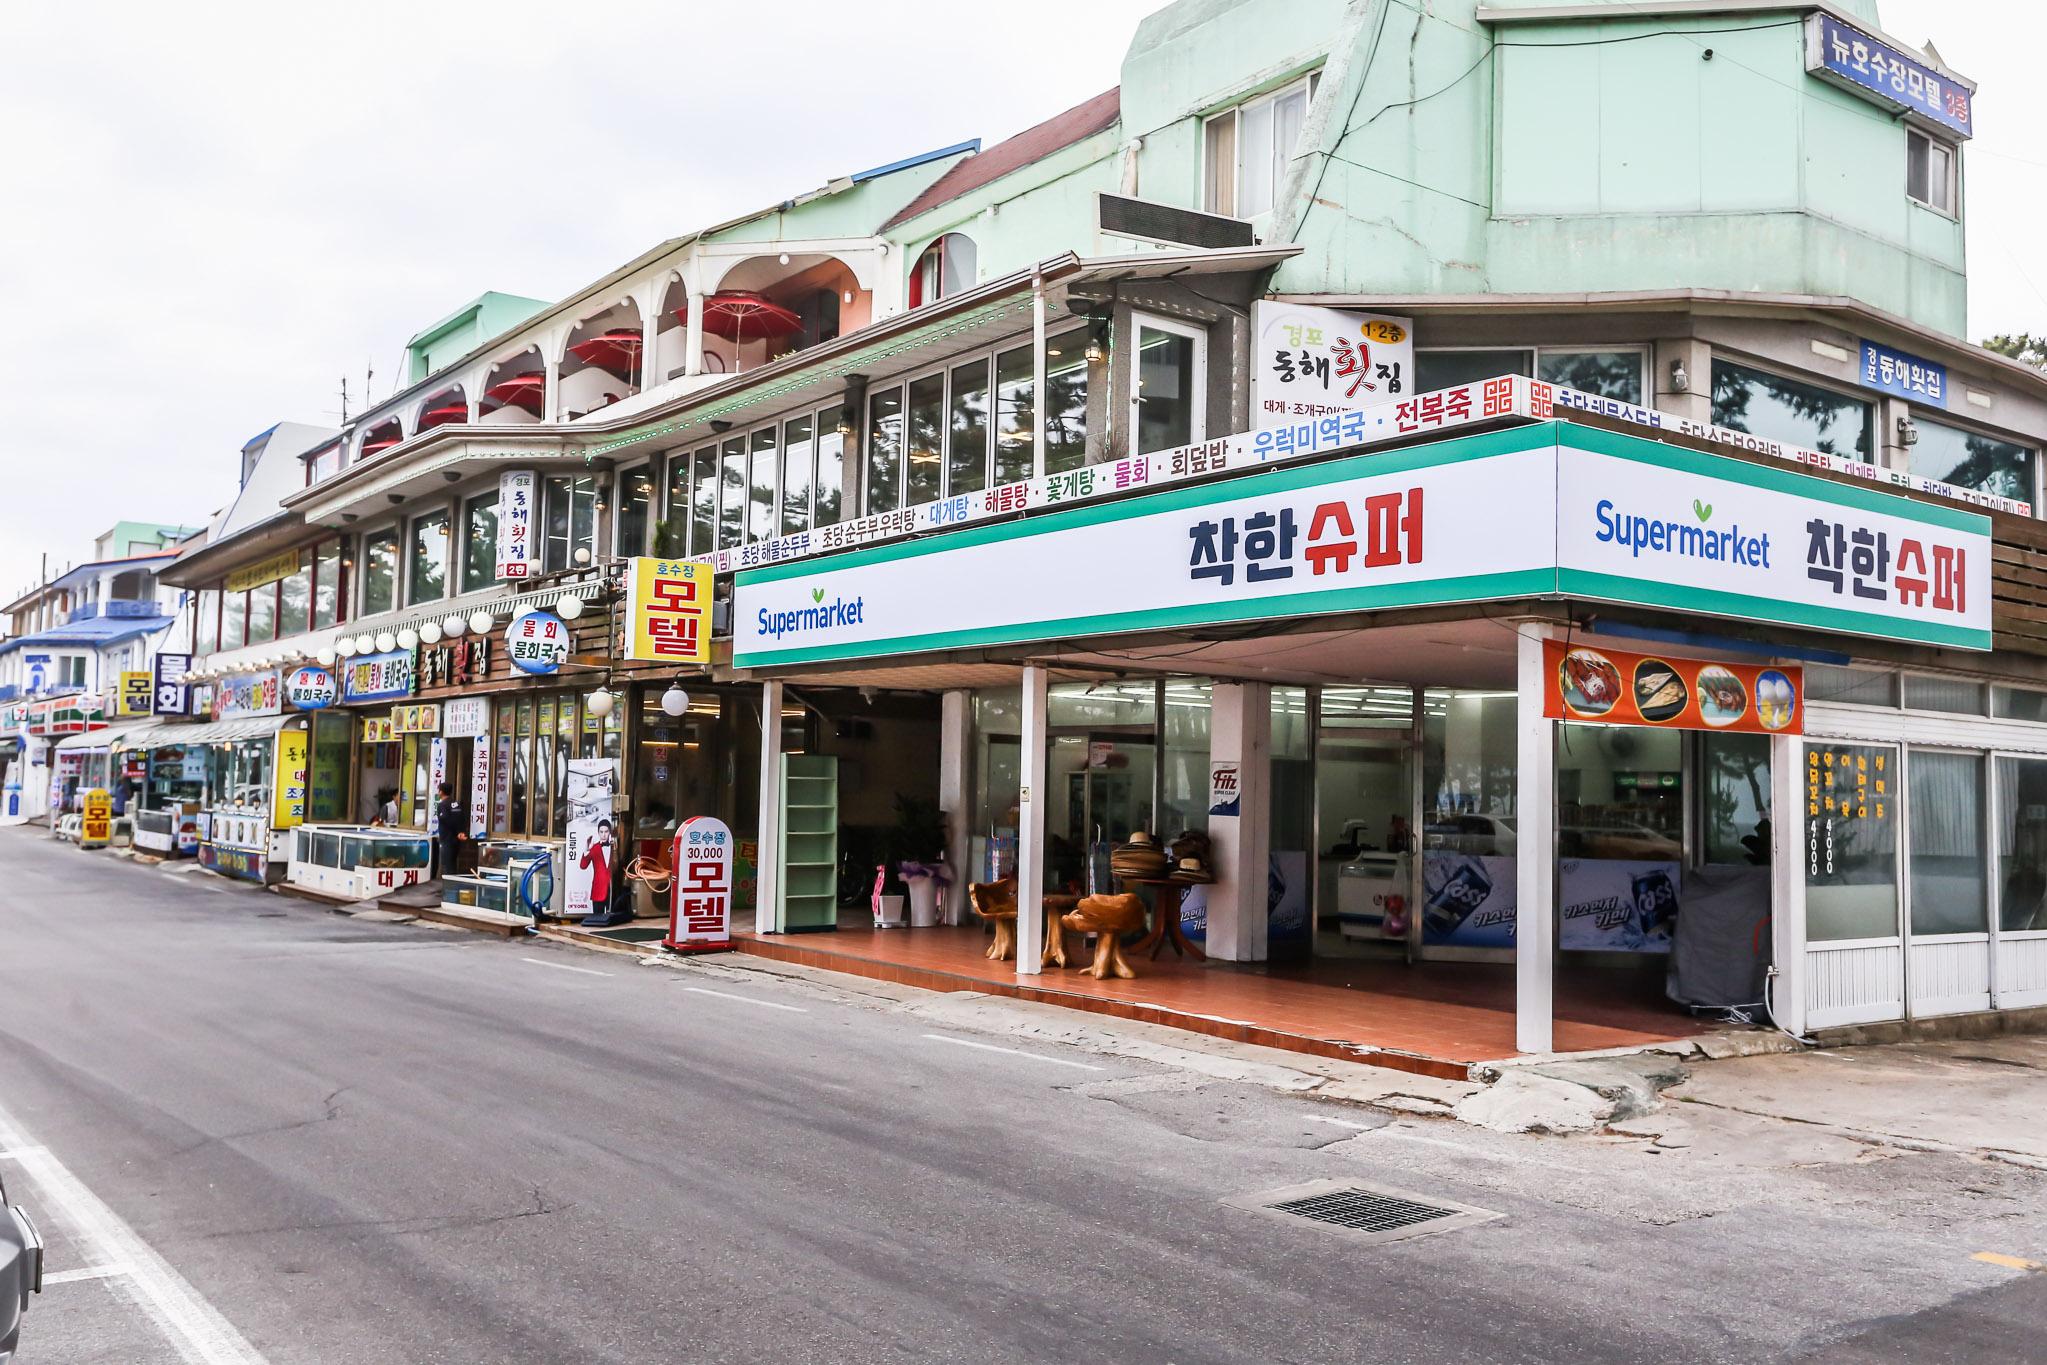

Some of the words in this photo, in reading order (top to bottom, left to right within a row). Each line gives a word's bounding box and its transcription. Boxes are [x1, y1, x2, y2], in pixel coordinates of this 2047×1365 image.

[1832, 29, 1941, 111] 뉴호수장모텔
[1283, 324, 1324, 348] 경포
[1272, 337, 1403, 399] 동해횟집
[1867, 347, 1877, 383] 경포
[1880, 354, 1940, 399] 동해횟집
[929, 496, 969, 524] 대게탕
[985, 483, 1029, 513] 해물탕
[1046, 469, 1095, 502] 꽃게탕
[1114, 456, 1150, 489] 물회
[1170, 440, 1229, 476] 회덮밥
[1253, 410, 1366, 461] 우럭미역국
[1395, 387, 1473, 433] 전복죽
[511, 491, 528, 560] 동해횟집
[1190, 487, 1424, 586] 착한슈퍼
[1596, 499, 1770, 569] Supermarket
[657, 563, 695, 578] 호수장
[1807, 518, 1966, 613] 착한슈퍼
[646, 579, 701, 656] 모텔
[758, 597, 864, 640] Supermarket
[157, 656, 187, 713] 물회
[423, 637, 486, 685] 동해횟집
[125, 679, 151, 711] 모텔
[687, 847, 723, 860] 30,000
[688, 831, 726, 846] 호수장
[682, 862, 728, 933] 모텔
[1473, 906, 1516, 927] 카스먼
